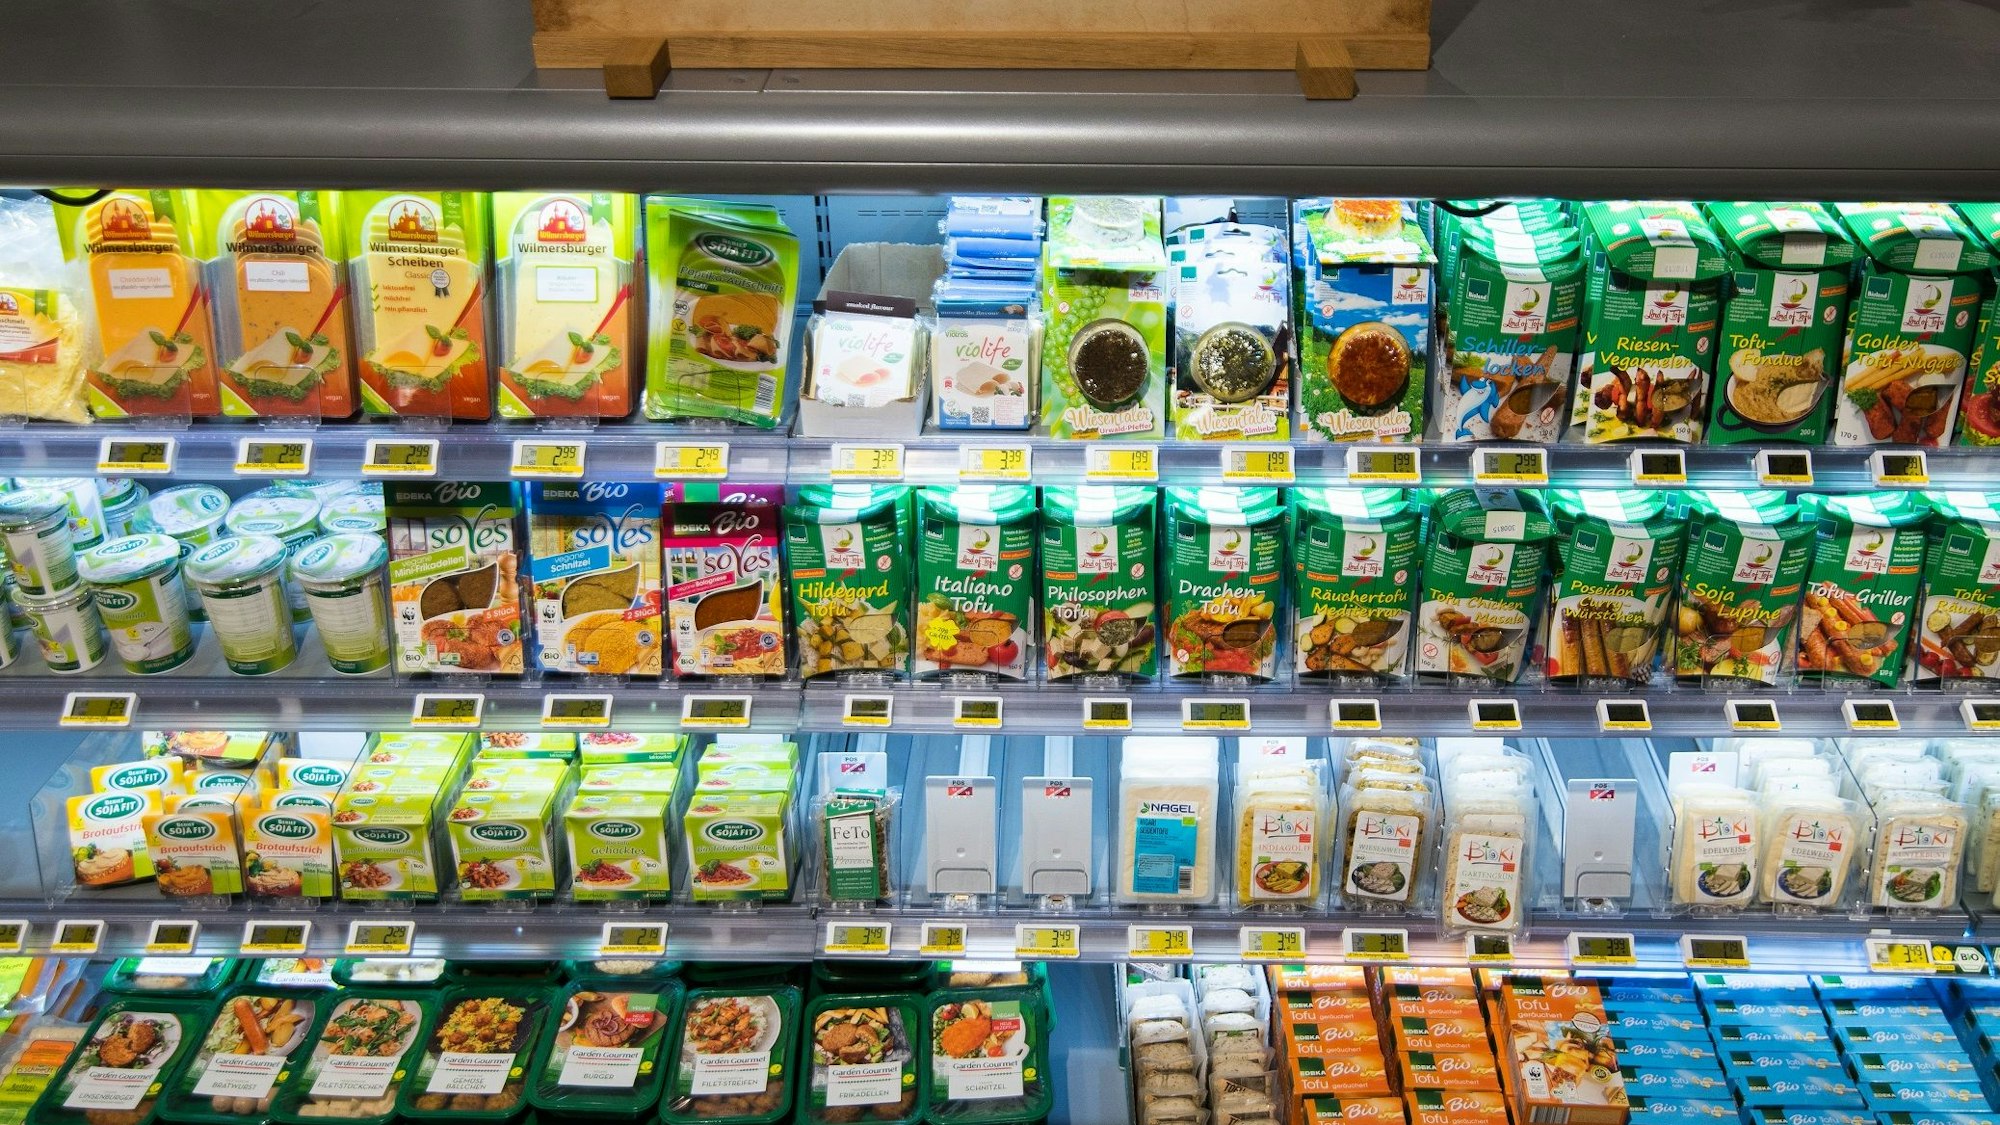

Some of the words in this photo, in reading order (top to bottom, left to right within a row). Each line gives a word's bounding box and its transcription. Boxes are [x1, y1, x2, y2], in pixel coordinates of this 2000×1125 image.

[103, 230, 151, 241] Wilmersburger
[248, 231, 294, 240] Wilmersburger
[390, 231, 437, 241] Wilmersburger
[539, 232, 585, 241] Wilmersburger
[84, 243, 173, 254] Wilmersburger
[226, 242, 317, 254] Wilmersburger
[369, 242, 460, 256] Wilmersburger
[518, 243, 607, 255] Wilmersburger
[388, 257, 443, 268] Scheiben
[383, 284, 415, 292] laktosefrei
[1529, 319, 1544, 332] Tofu
[1463, 335, 1547, 357] Schiller-
[1617, 336, 1679, 352] Riesen-
[1730, 334, 1775, 350] Tofu-
[1857, 334, 1920, 351] Golden
[956, 337, 1011, 365] violife
[1601, 353, 1693, 369] Vegarnelen
[1742, 352, 1804, 366] Fondue
[1483, 362, 1547, 377] locken
[1244, 425, 1276, 434] Almliebe
[1391, 426, 1409, 434] Hirte
[396, 492, 432, 500] EDEKA
[438, 481, 481, 503] Bio
[543, 490, 579, 498] EDEKA
[582, 481, 629, 502] Bio
[673, 524, 710, 532] EDEKA
[713, 511, 759, 535] Bio
[401, 555, 432, 569] vegane
[550, 558, 591, 572] Schnitzel
[554, 552, 585, 564] vegane
[394, 555, 464, 578] Mini-Frikadellen
[799, 580, 889, 603] Hildegard
[935, 576, 1013, 597] Italiano
[1178, 579, 1266, 598] Drachen-
[1570, 580, 1634, 597] Poseidon
[1693, 583, 1735, 603] Soja
[1048, 585, 1148, 605] Philosophen
[1311, 587, 1407, 604] Räuchertofu
[1430, 587, 1461, 605] Tofu
[1466, 596, 1523, 611] Chicken
[1807, 582, 1912, 607] Tofu-Griller
[1954, 589, 1995, 603] Tofu-
[494, 606, 516, 618] Stück
[634, 607, 657, 618] Stück
[809, 603, 847, 617] Tofu
[951, 597, 994, 614] Tofu
[1055, 605, 1090, 620] Tofu
[1199, 600, 1240, 616] Tofu
[1313, 603, 1402, 617] Mediterran
[1579, 597, 1631, 614] Curry-
[1474, 611, 1524, 625] Masala
[1565, 606, 1645, 623] Würstchen
[1717, 603, 1781, 624] Lupine
[118, 773, 144, 785] SOJA
[146, 771, 159, 782] FIT
[302, 773, 324, 782] SOJA
[94, 803, 120, 816] SOJA
[122, 801, 137, 812] FIT
[1150, 804, 1195, 813] NAGEL
[832, 825, 870, 840] FeTo
[160, 843, 226, 854] Brotaufstrich
[256, 842, 323, 854] Brotaufstrich
[591, 846, 646, 855] Gehacktes
[1703, 846, 1748, 855] EDELWEISS
[1791, 847, 1835, 858] EDELWEISS
[1547, 983, 1588, 997] Bio
[1517, 999, 1549, 1011] Tofu
[572, 1050, 606, 1058] Garden
[607, 1050, 639, 1059] Gourmet
[700, 1057, 732, 1065] Garden
[734, 1056, 766, 1064] Gourmet
[215, 1057, 250, 1067] Garden
[251, 1058, 280, 1069] Gourmet
[953, 1061, 981, 1070] Garden
[983, 1060, 1019, 1069] Gourmet
[832, 1069, 861, 1077] Garden
[862, 1067, 897, 1075] Gourmet
[212, 1082, 257, 1090] BRATWURST
[1301, 1080, 1329, 1090] Tofu
[1640, 1074, 1667, 1085] Bio
[1670, 1076, 1689, 1085] Tofu
[839, 1090, 890, 1098] FRIKADELLEN
